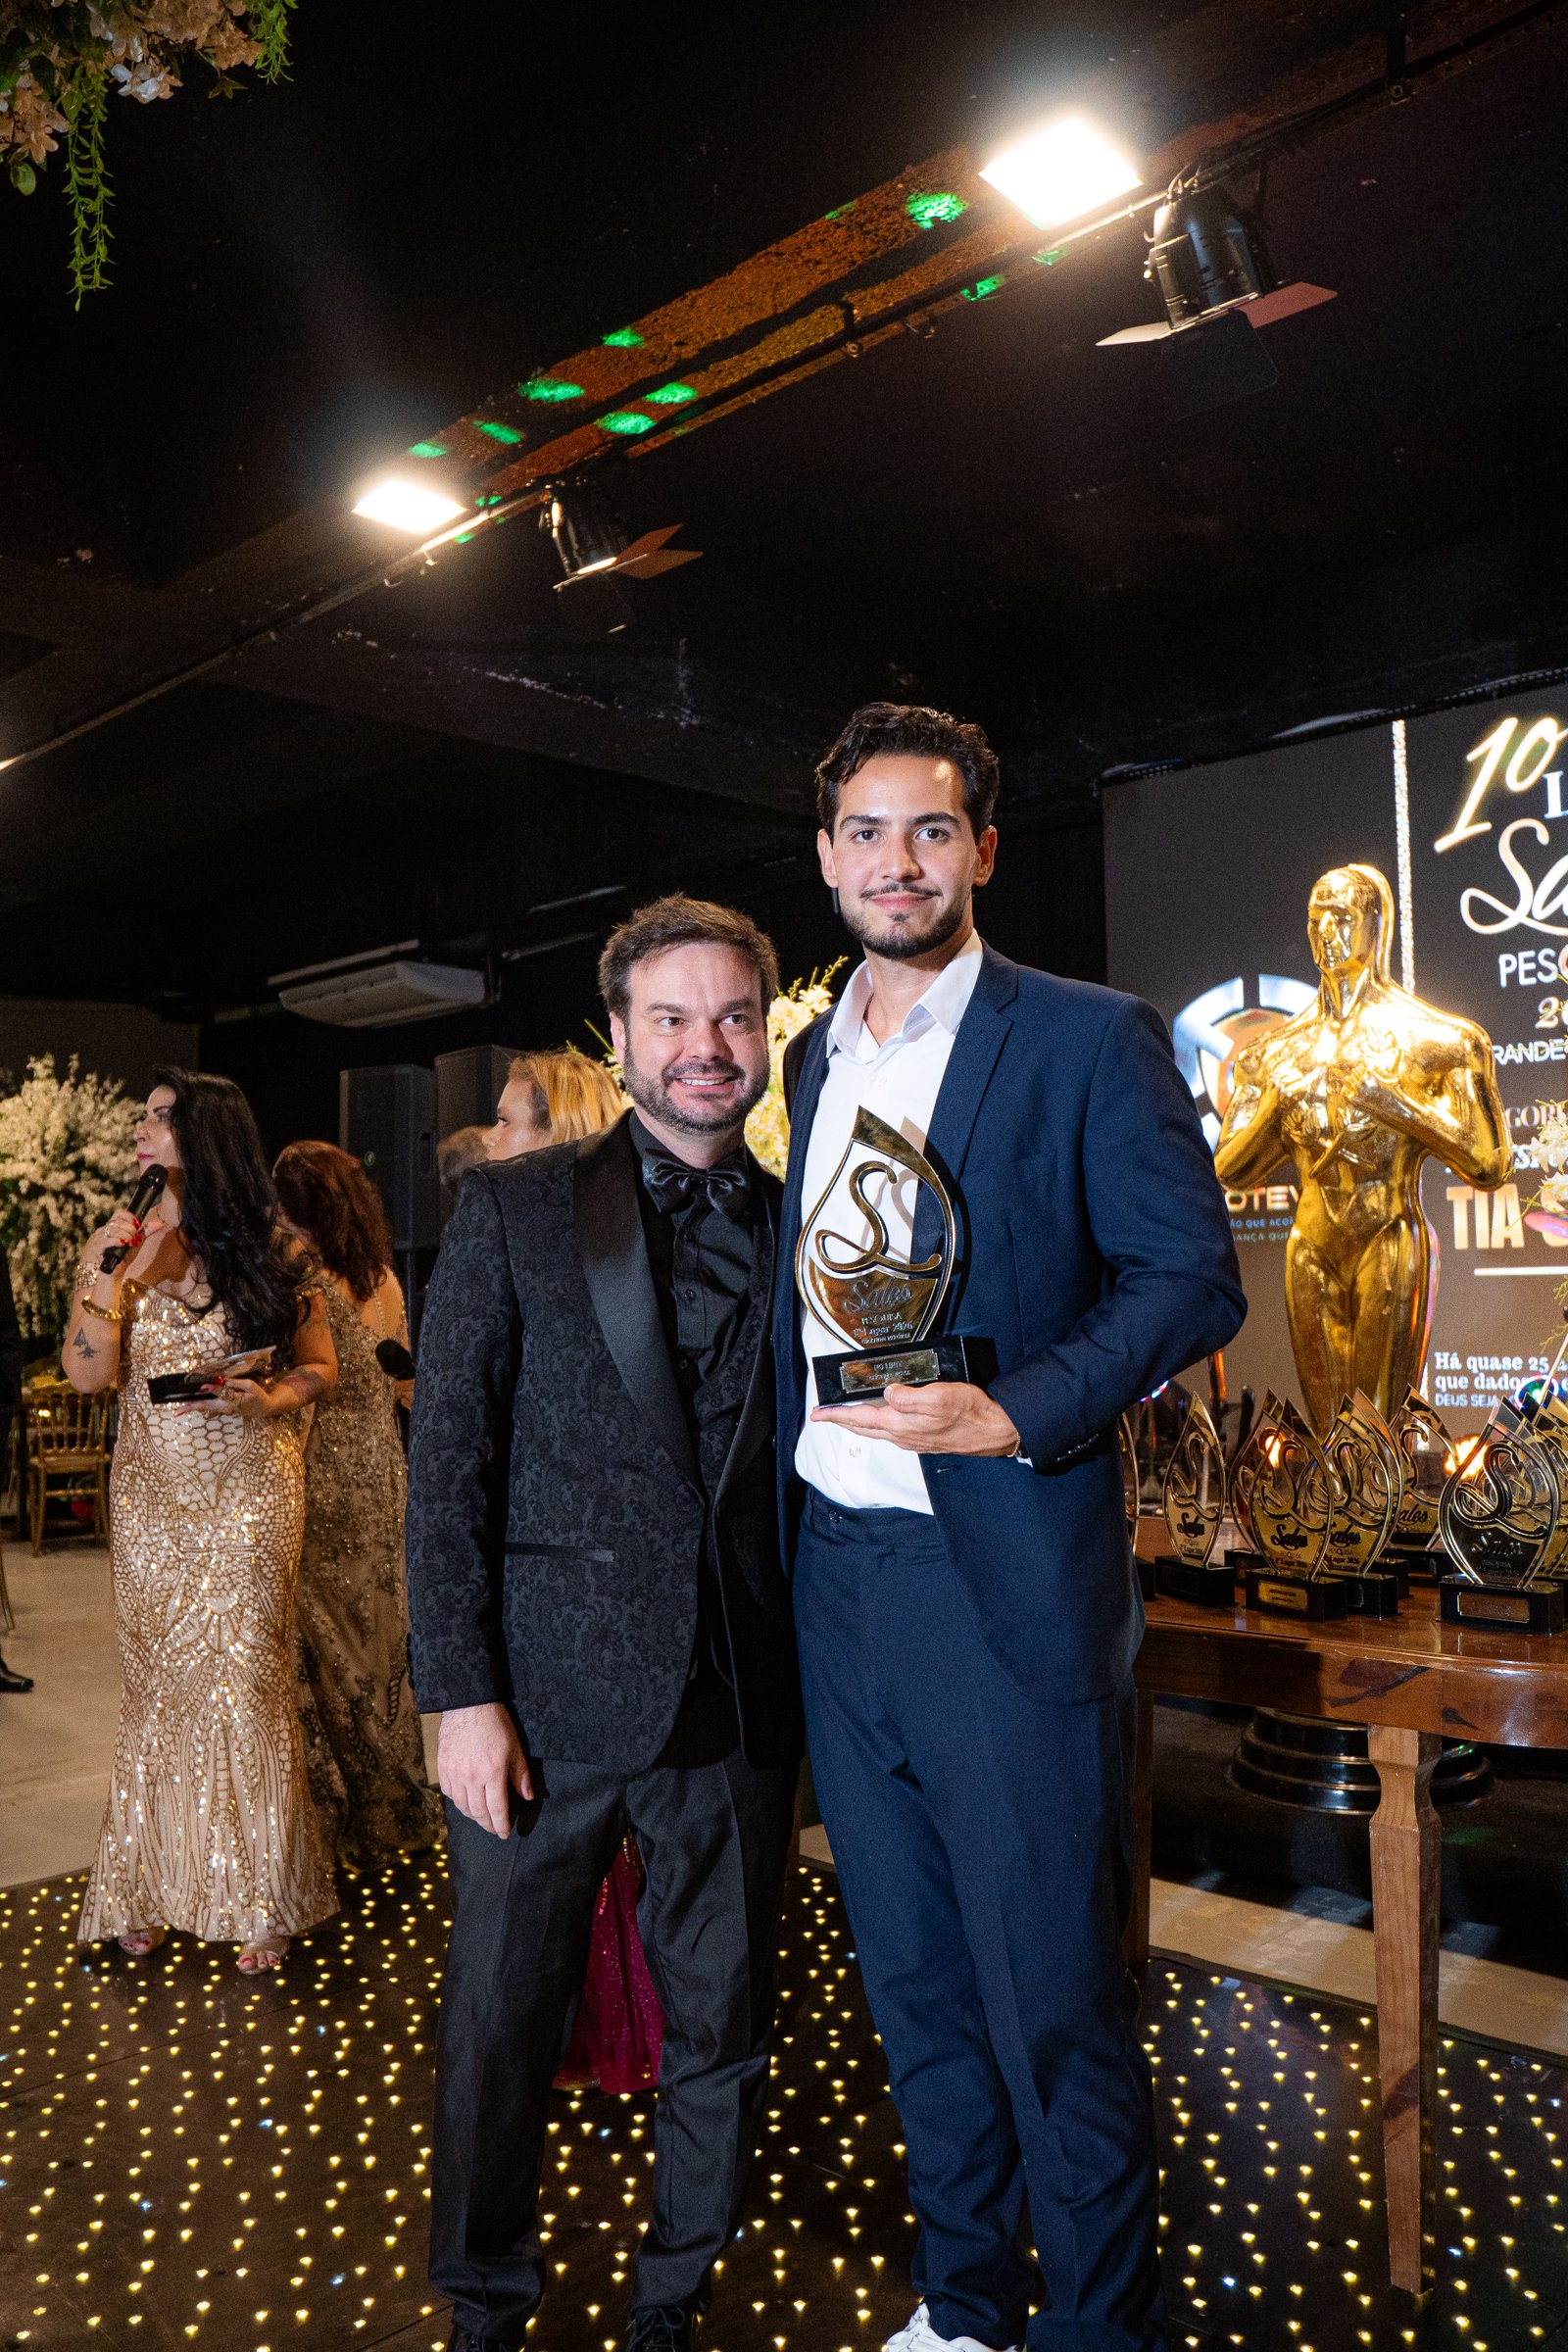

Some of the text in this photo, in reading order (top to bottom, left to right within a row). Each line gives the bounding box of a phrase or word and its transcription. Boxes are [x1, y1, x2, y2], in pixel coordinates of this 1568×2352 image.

[1497, 944, 1568, 989] PES
[1492, 1038, 1567, 1066] RANDE
[1446, 1183, 1525, 1250] TIA
[843, 1276, 912, 1315] Sales
[1434, 1351, 1462, 1371] Há
[1466, 1355, 1523, 1374] quase
[1528, 1356, 1549, 1373] 25
[1435, 1375, 1469, 1393] que
[1435, 1393, 1468, 1407] DEUS
[1398, 1503, 1429, 1526] ales
